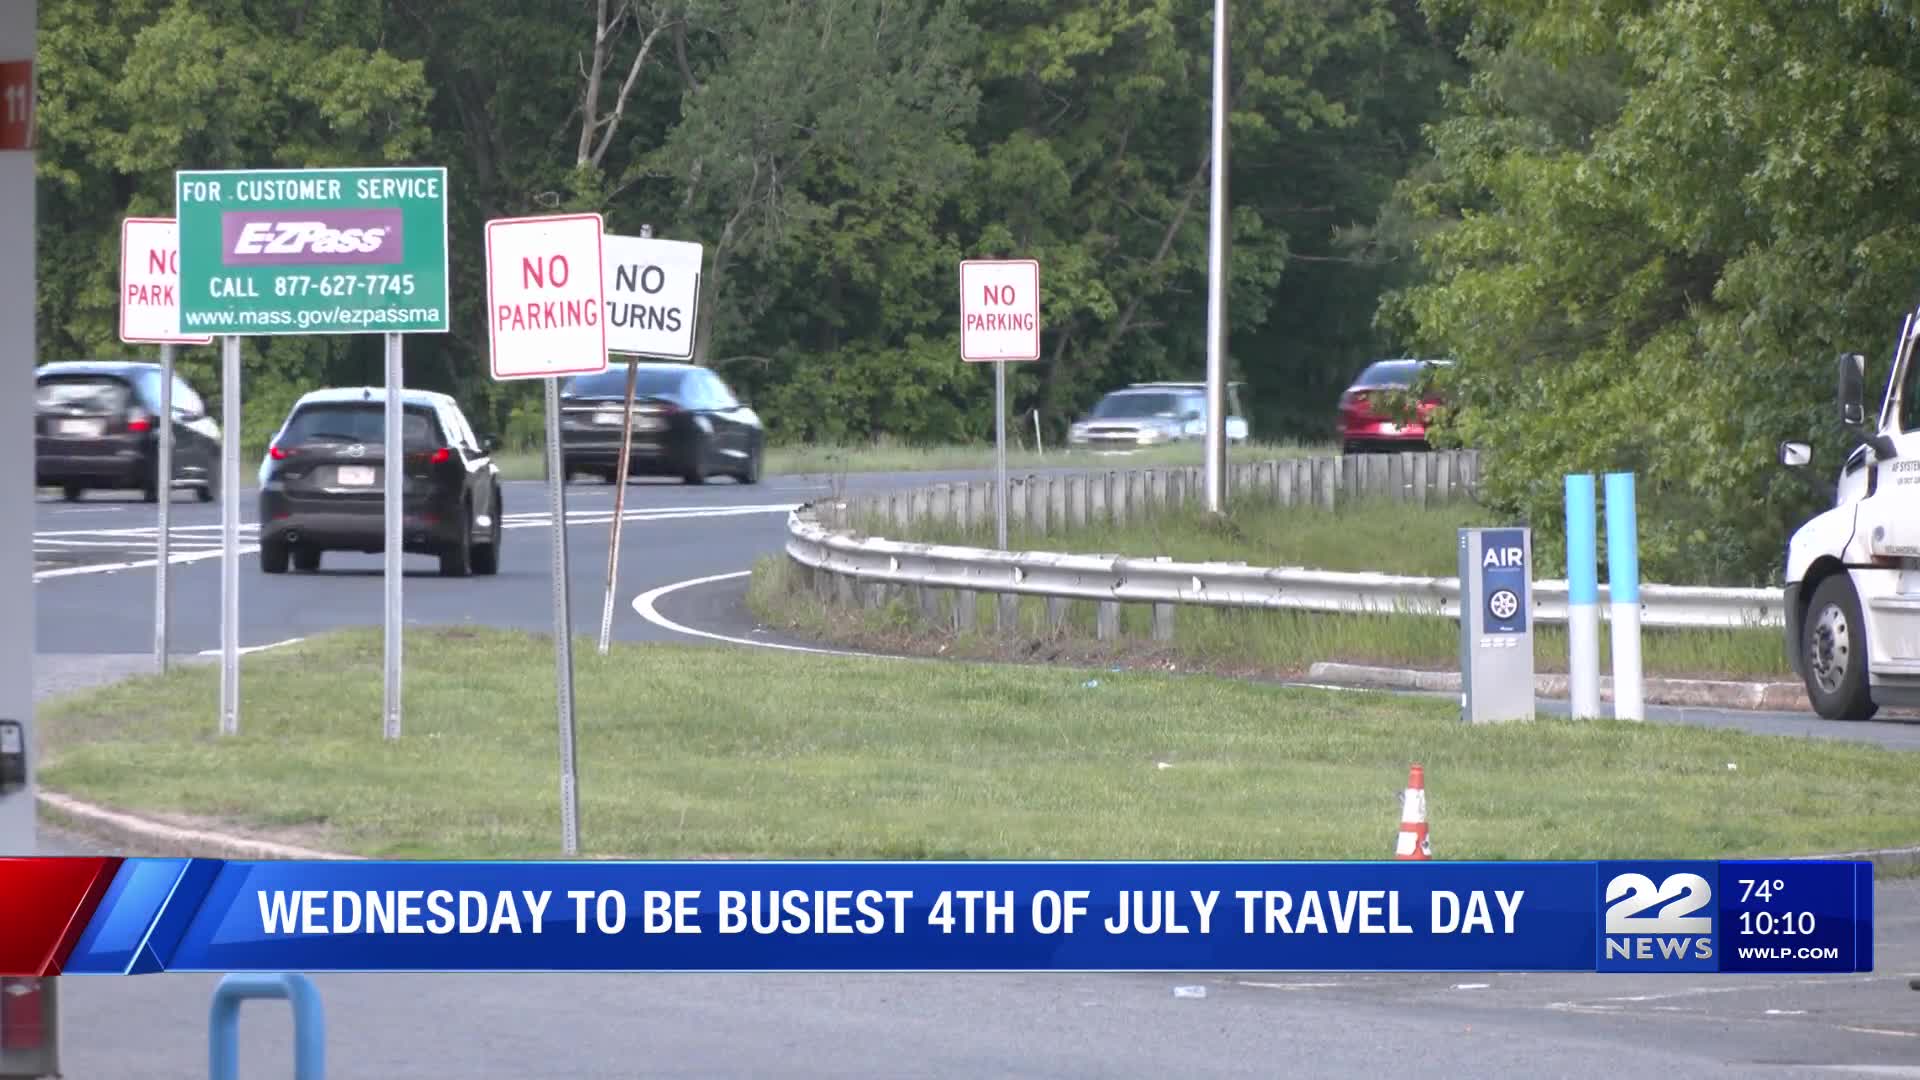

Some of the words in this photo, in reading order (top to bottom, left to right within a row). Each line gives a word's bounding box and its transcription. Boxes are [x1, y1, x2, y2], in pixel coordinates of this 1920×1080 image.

[183, 182, 221, 201] FOR
[236, 180, 341, 200] CUSTOMER
[357, 178, 439, 199] SERVICE
[523, 254, 569, 289] NO
[616, 265, 665, 294] NO
[209, 277, 259, 298] CALL
[274, 274, 415, 296] 877-627-7745
[983, 285, 1015, 306] NO
[185, 306, 440, 327] www.mass.gov/ezpassma
[498, 298, 597, 332] PARKING
[967, 313, 1033, 332] PARKING
[1483, 547, 1523, 568] AIR
